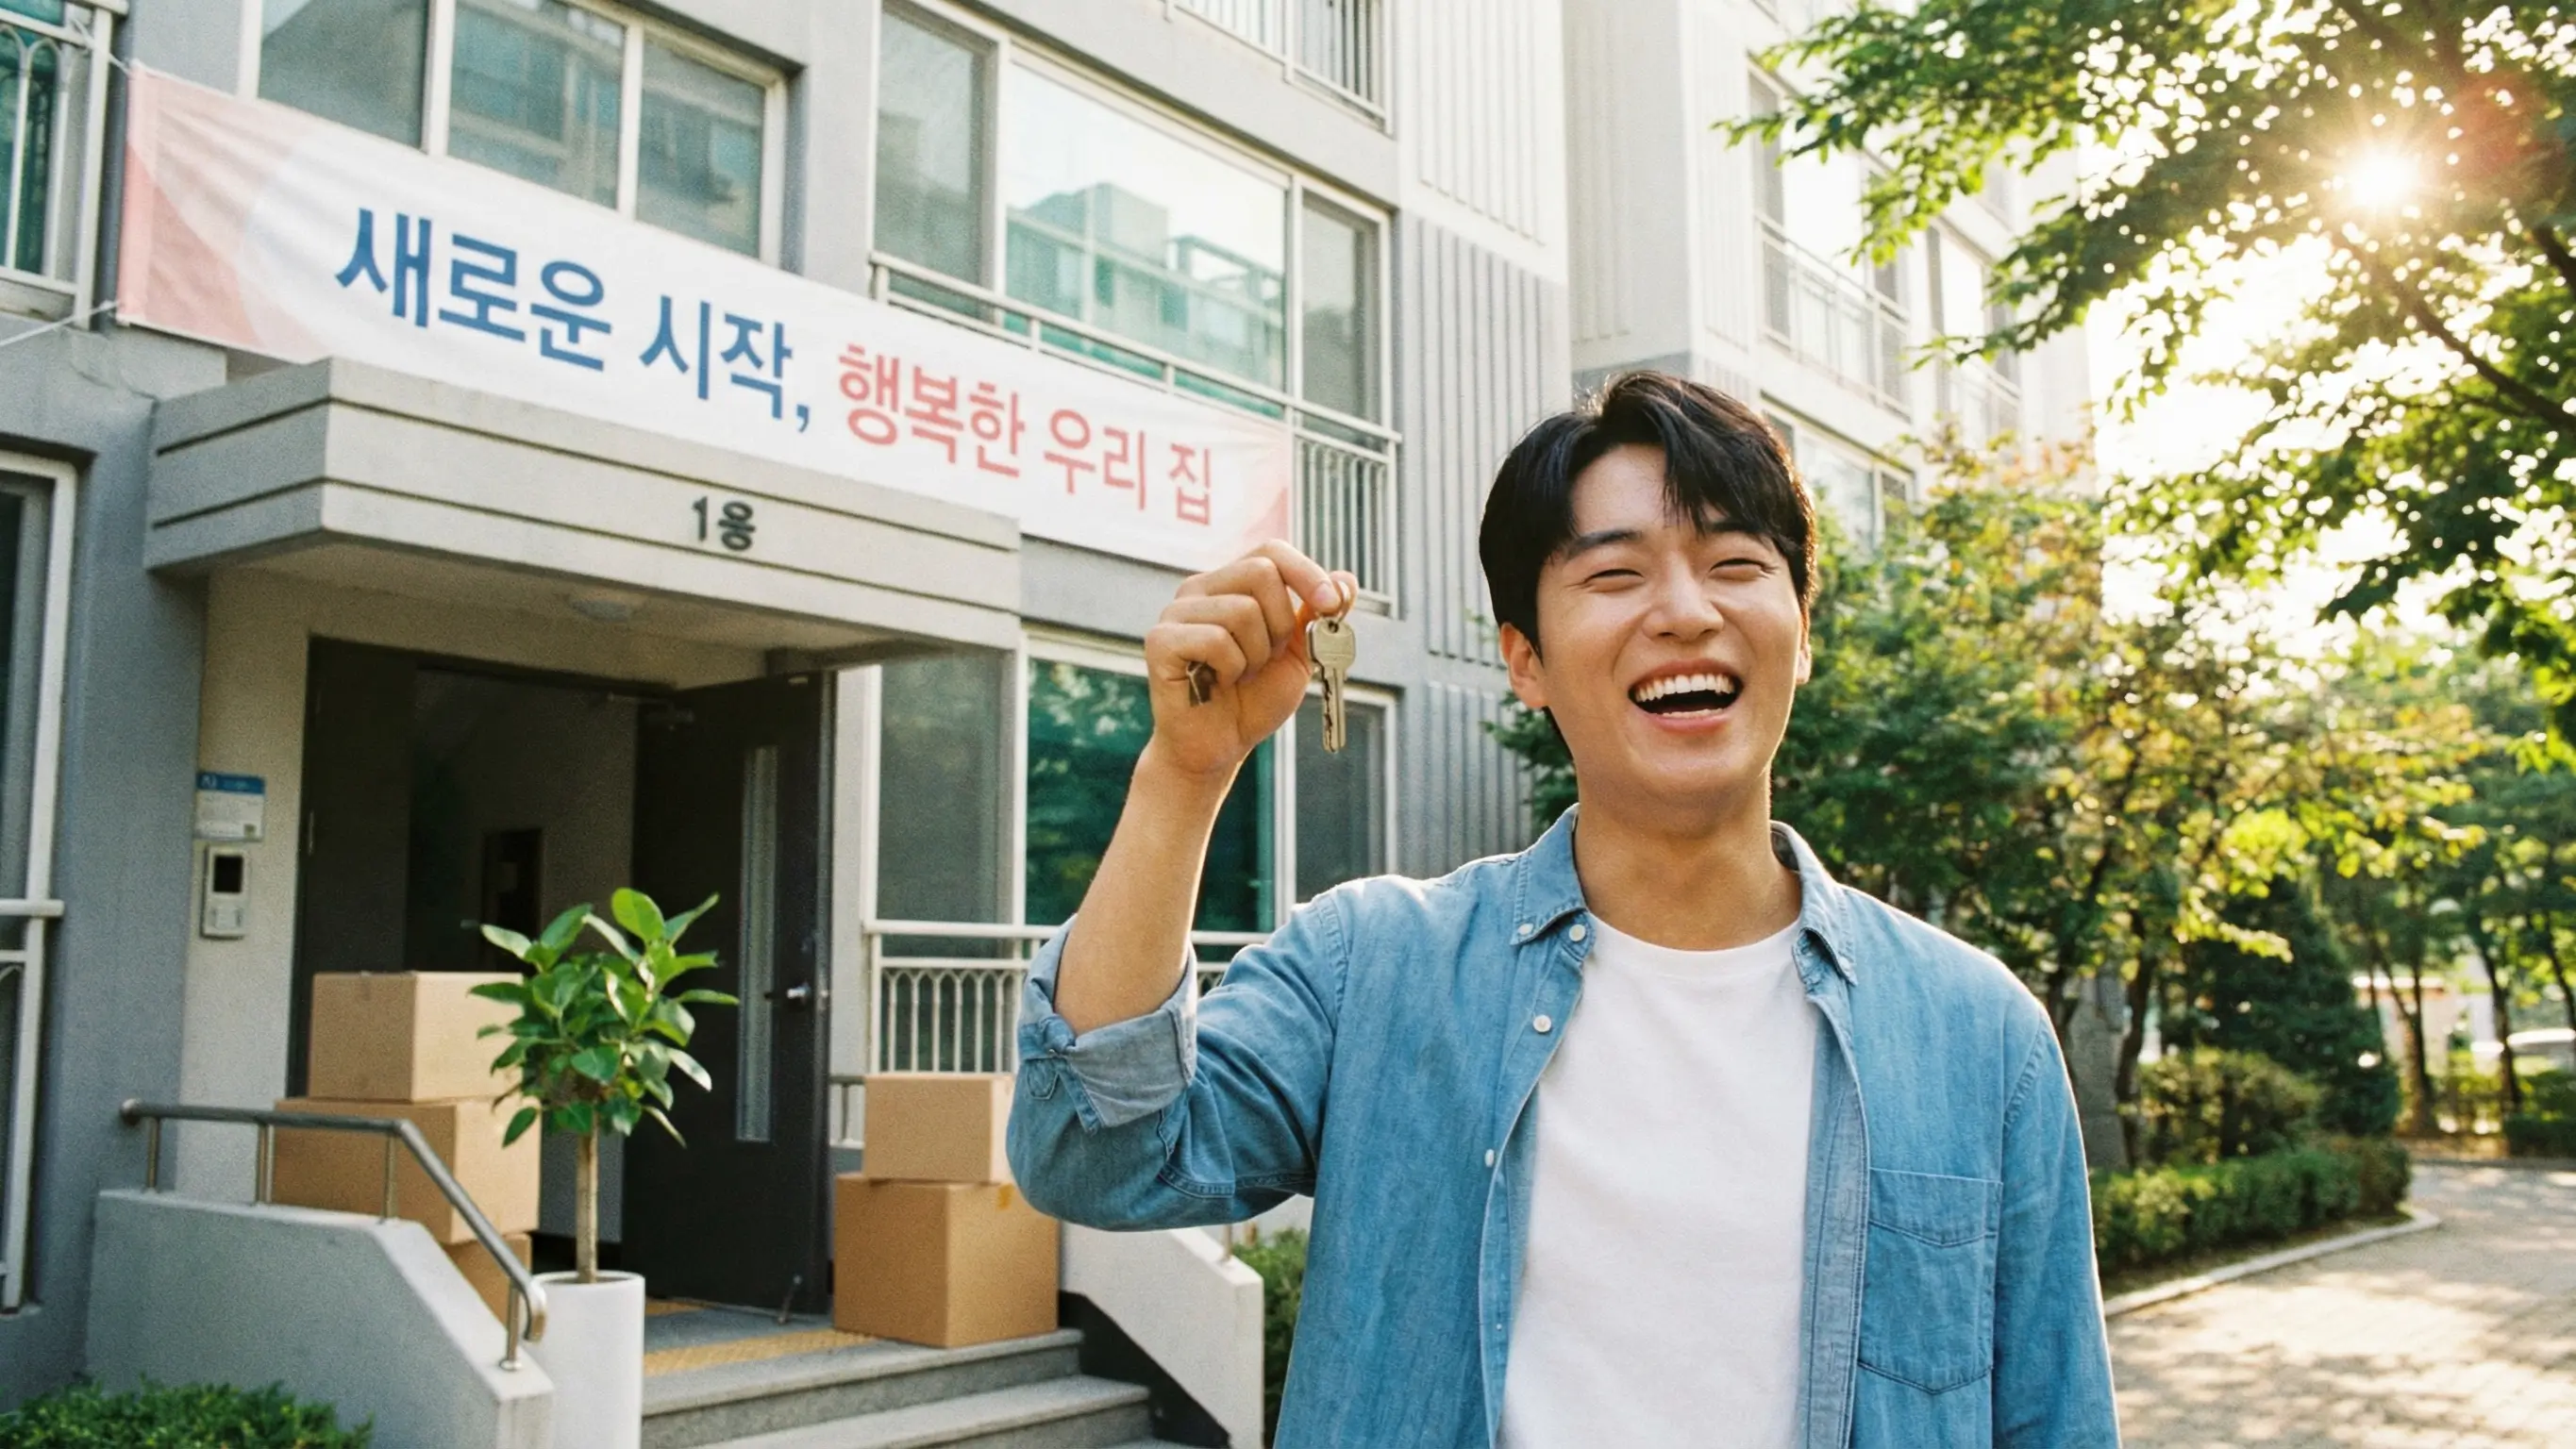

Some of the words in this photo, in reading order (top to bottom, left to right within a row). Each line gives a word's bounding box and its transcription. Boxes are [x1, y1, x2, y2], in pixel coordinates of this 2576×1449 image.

[336, 207, 611, 372] 새로운
[640, 294, 810, 433] 시작,
[838, 342, 1025, 478] 행복한
[1045, 409, 1147, 509] 우리
[1168, 442, 1210, 525] 집
